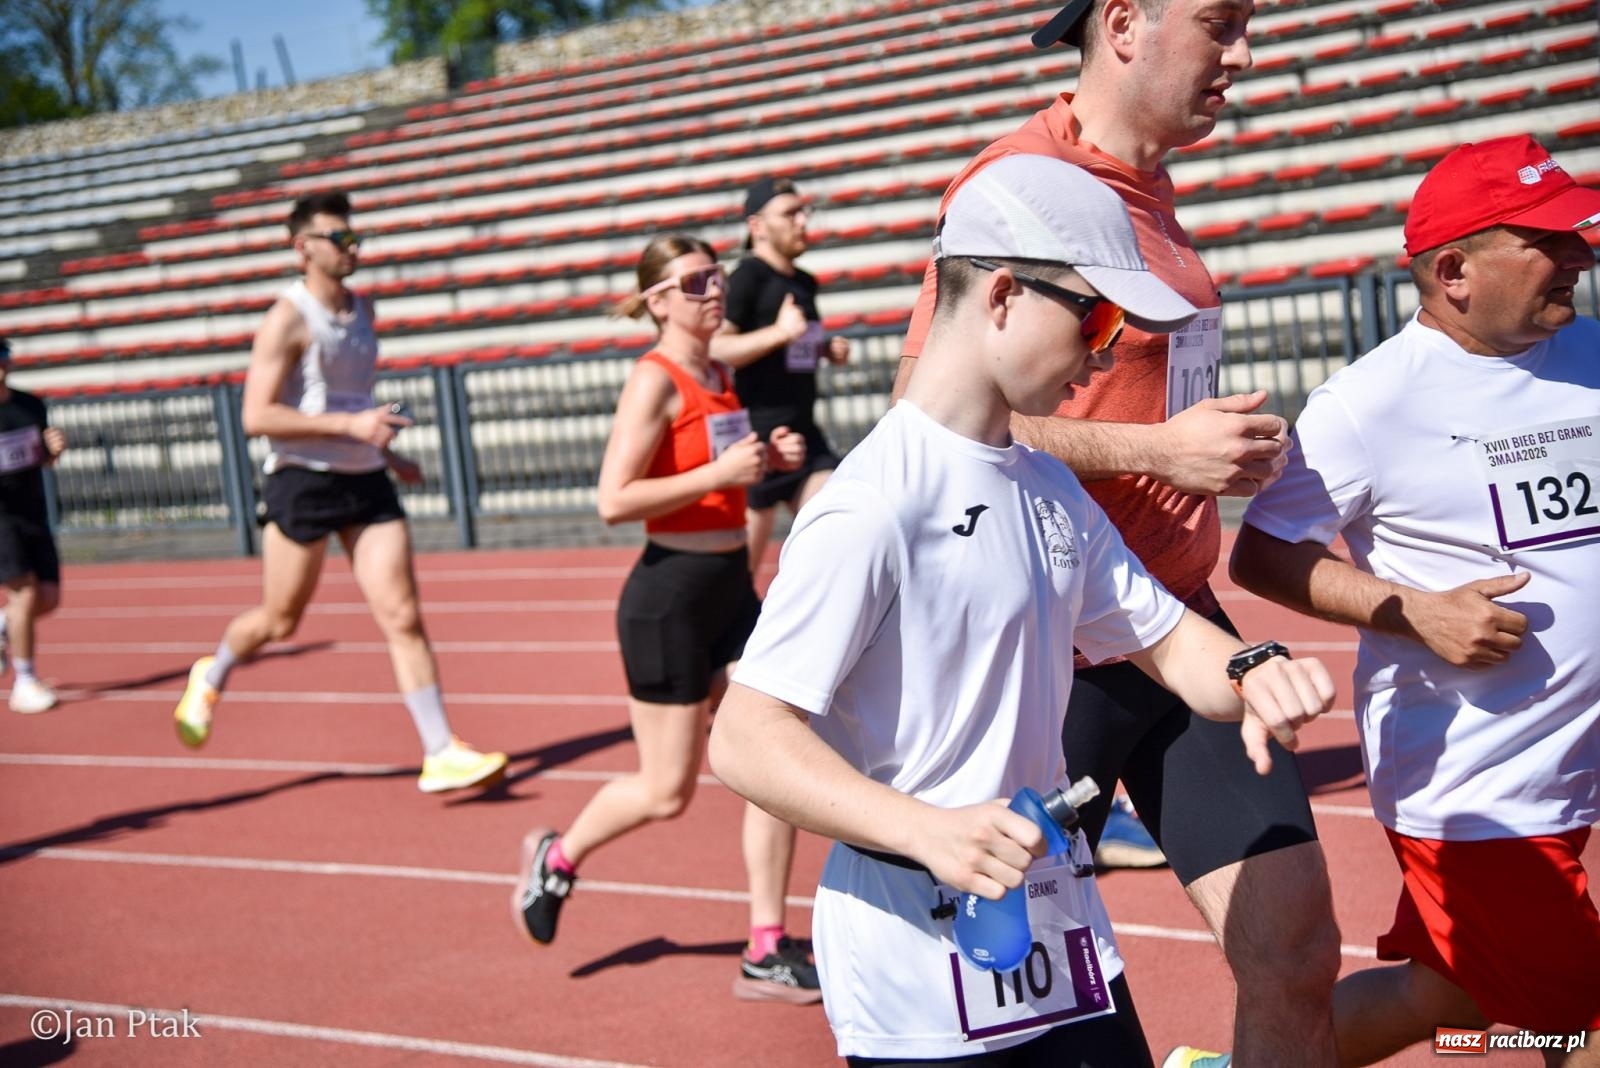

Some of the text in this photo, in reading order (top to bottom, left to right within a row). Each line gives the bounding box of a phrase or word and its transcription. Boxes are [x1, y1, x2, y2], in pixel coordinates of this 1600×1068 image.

[1483, 425, 1592, 454] XVIII BIEG BEZ GRANIC
[1488, 446, 1547, 467] 3MAJA2026
[1515, 471, 1599, 525] 132
[1028, 880, 1058, 899] GRANIC
